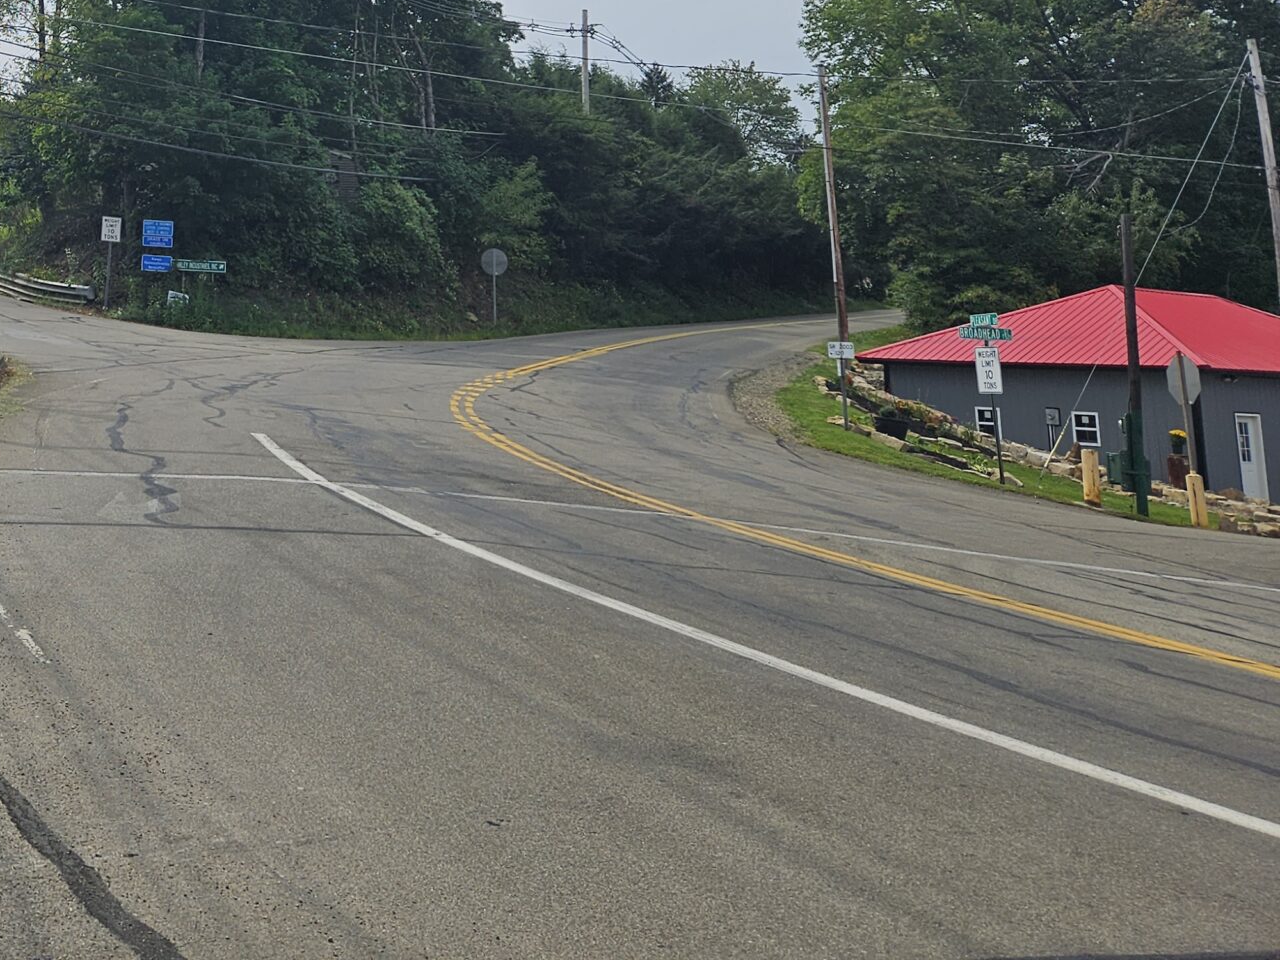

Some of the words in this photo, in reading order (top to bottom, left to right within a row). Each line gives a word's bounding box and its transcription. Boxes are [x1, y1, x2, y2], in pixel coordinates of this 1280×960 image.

[971, 313, 991, 327] PLEASANT
[960, 327, 1001, 339] BROADHEAD
[978, 350, 996, 358] WEIGHT
[981, 359, 994, 367] LIMIT
[984, 369, 994, 380] 10
[983, 381, 998, 390] TONS
